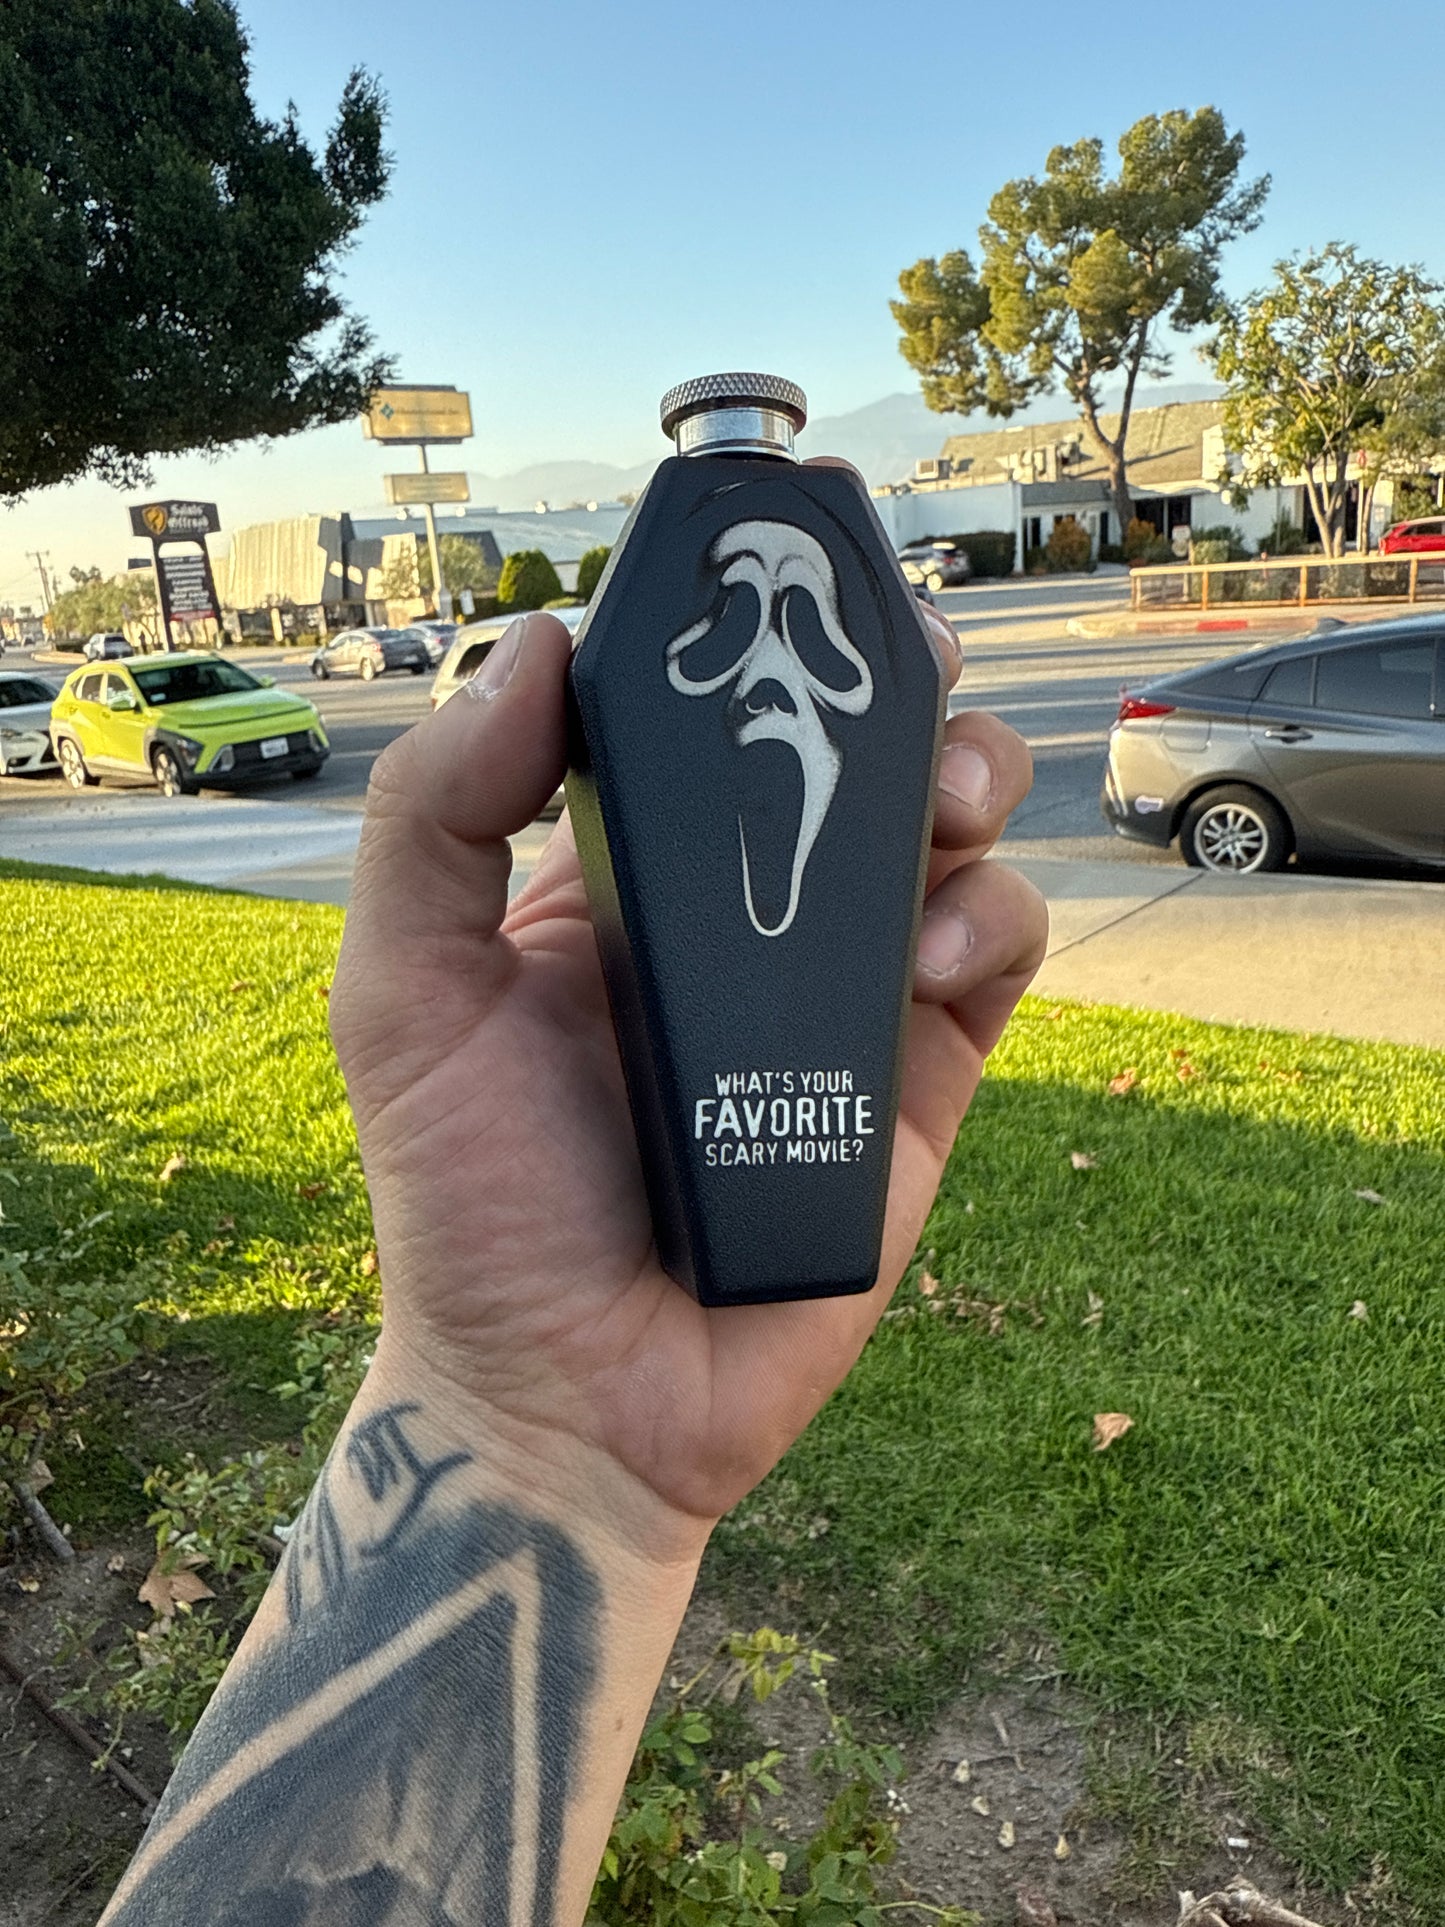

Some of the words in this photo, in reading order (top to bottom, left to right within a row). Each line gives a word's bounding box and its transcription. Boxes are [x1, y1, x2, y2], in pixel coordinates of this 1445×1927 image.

[715, 1071, 794, 1096] WHAT'S
[800, 1070, 853, 1093] YOUR
[694, 1095, 875, 1139] FAVORITE
[705, 1142, 778, 1166] SCARY
[786, 1138, 864, 1163] MOVIE?
